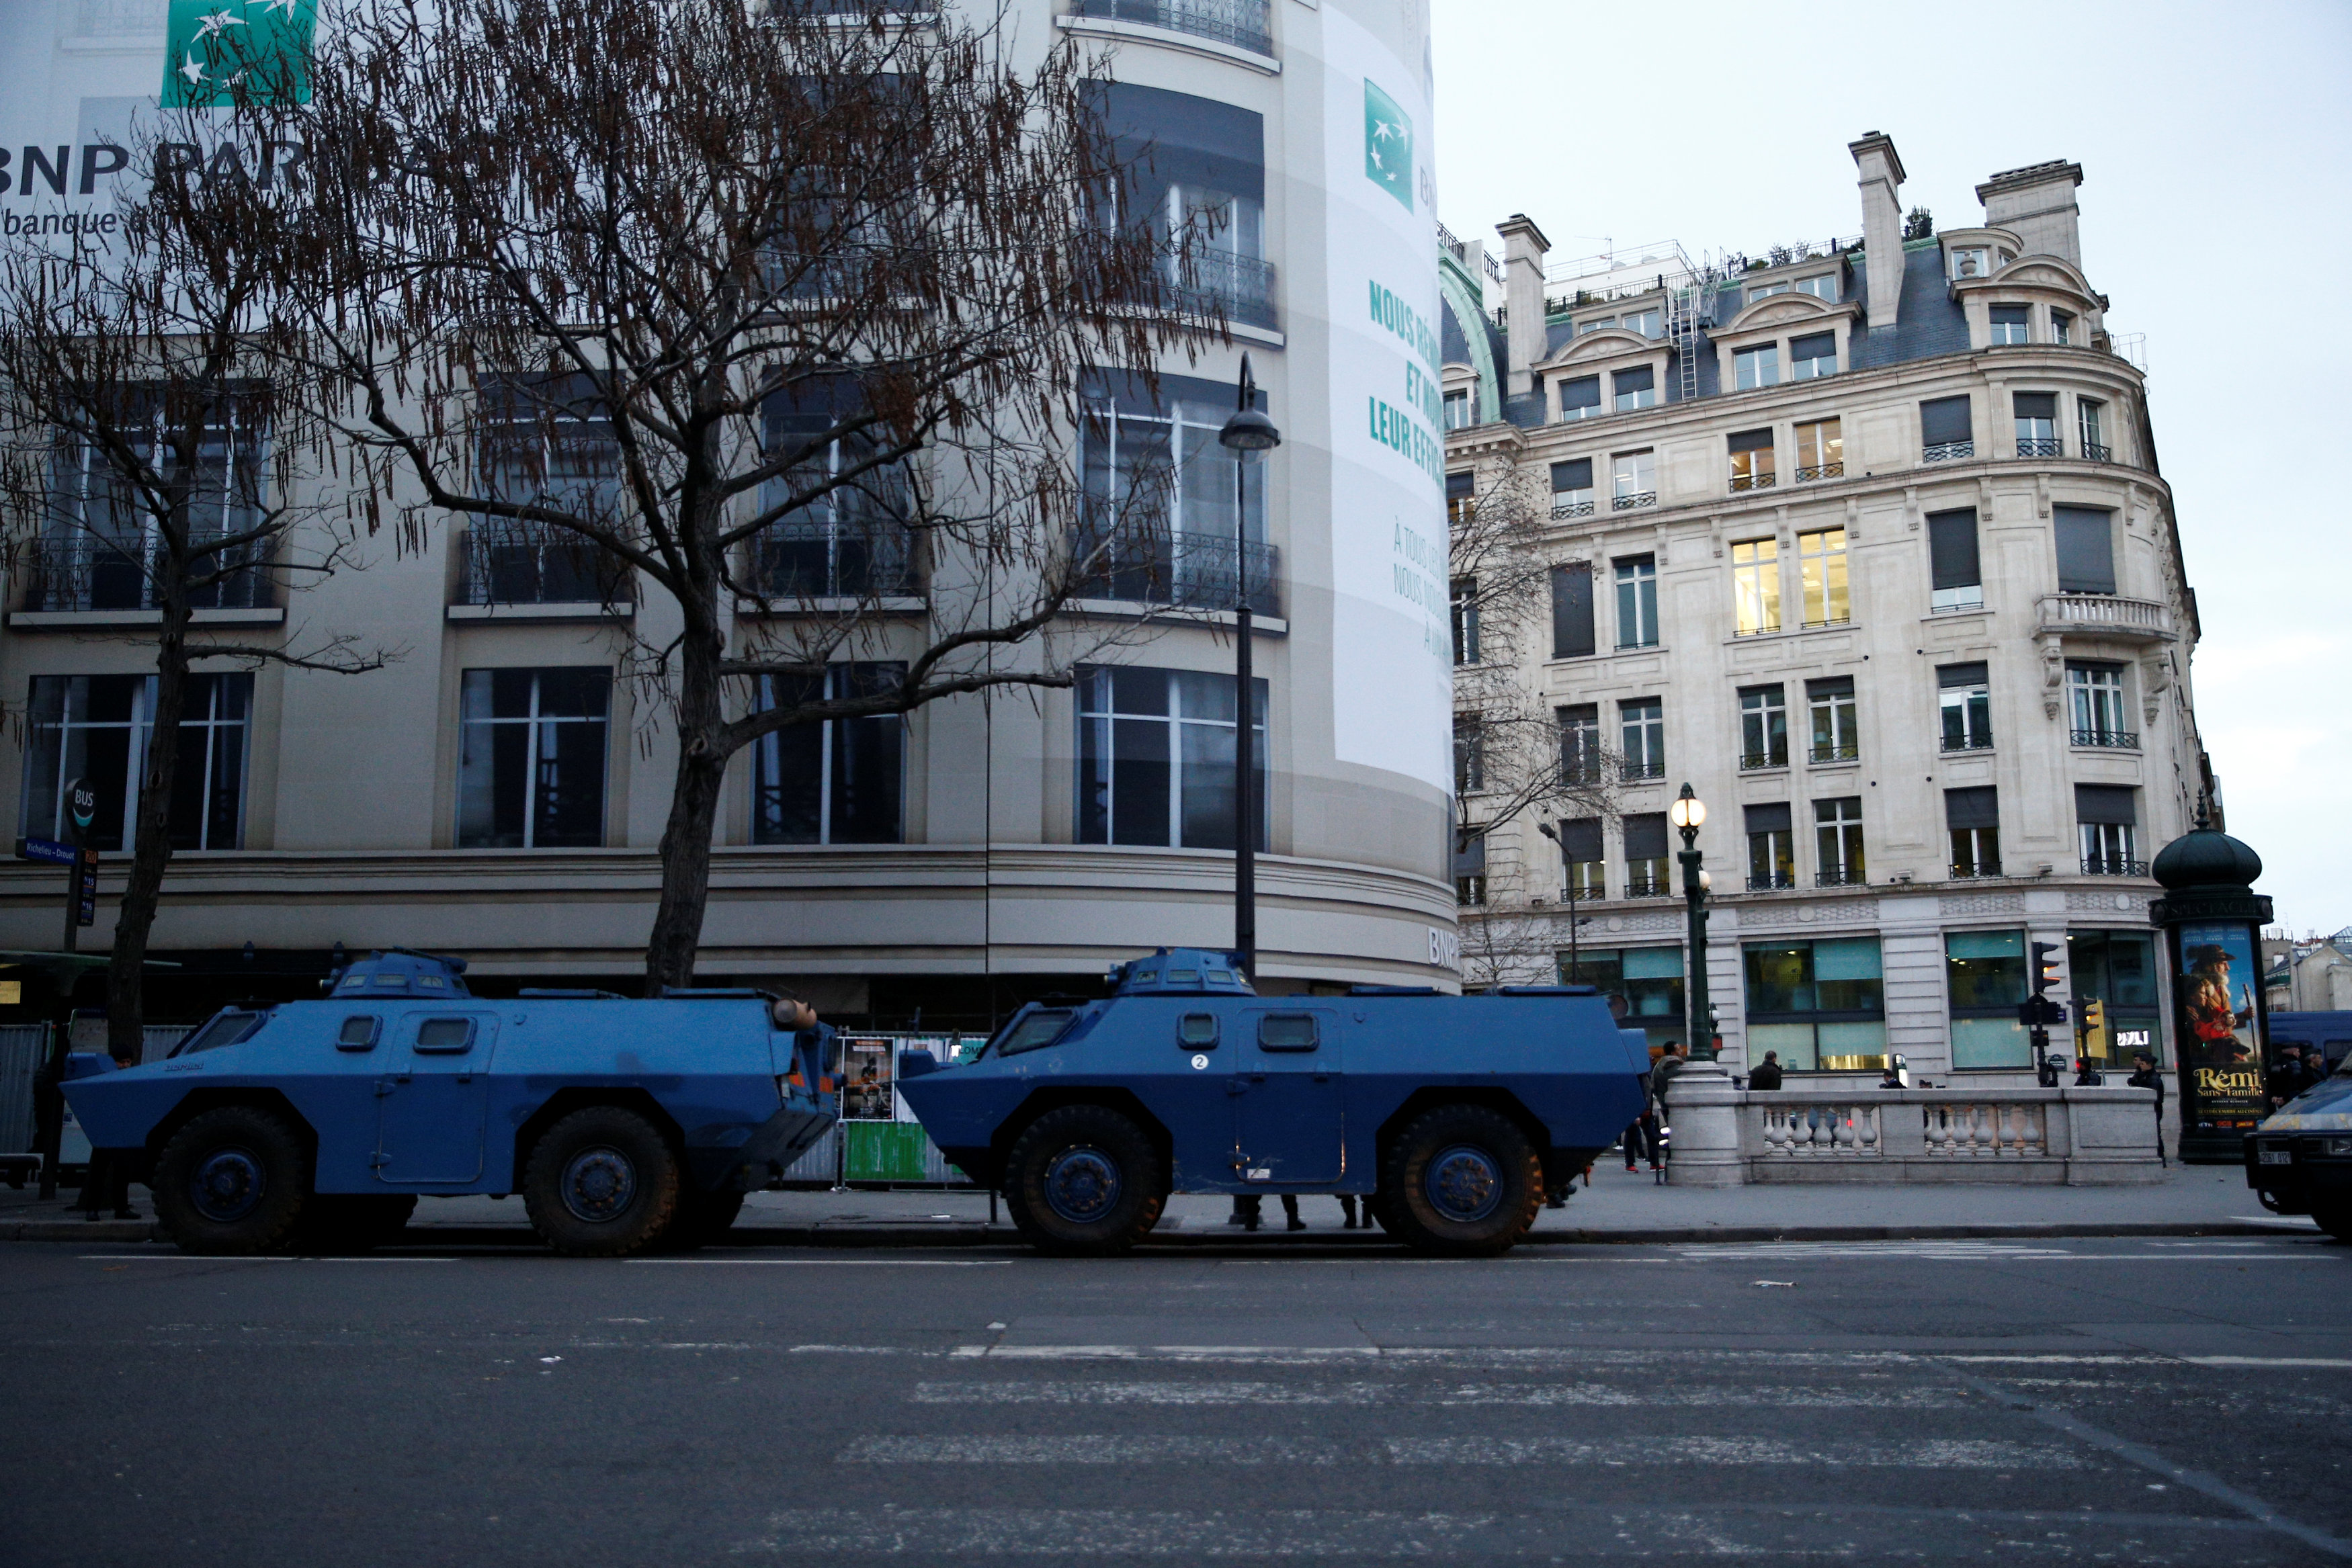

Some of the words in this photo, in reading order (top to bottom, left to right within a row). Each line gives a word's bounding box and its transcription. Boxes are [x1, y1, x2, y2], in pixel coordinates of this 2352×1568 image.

[0, 143, 129, 195] NP
[3, 208, 117, 239] banque
[1369, 279, 1415, 349] NOUS
[1406, 359, 1421, 409] ET
[1369, 396, 1411, 460] LEUR
[1394, 515, 1401, 554] À
[1404, 527, 1427, 568] TOUS
[1393, 563, 1422, 605] NOUS
[75, 789, 94, 807] BUS
[27, 842, 52, 855] Richelieu
[56, 849, 75, 861] Drouot
[87, 851, 96, 862] 20
[1427, 926, 1454, 967] BNP
[1195, 1056, 1204, 1068] 2
[2193, 1068, 2260, 1092] Rémi
[2197, 1088, 2221, 1096] Sans
[2226, 1086, 2263, 1096] Famille
